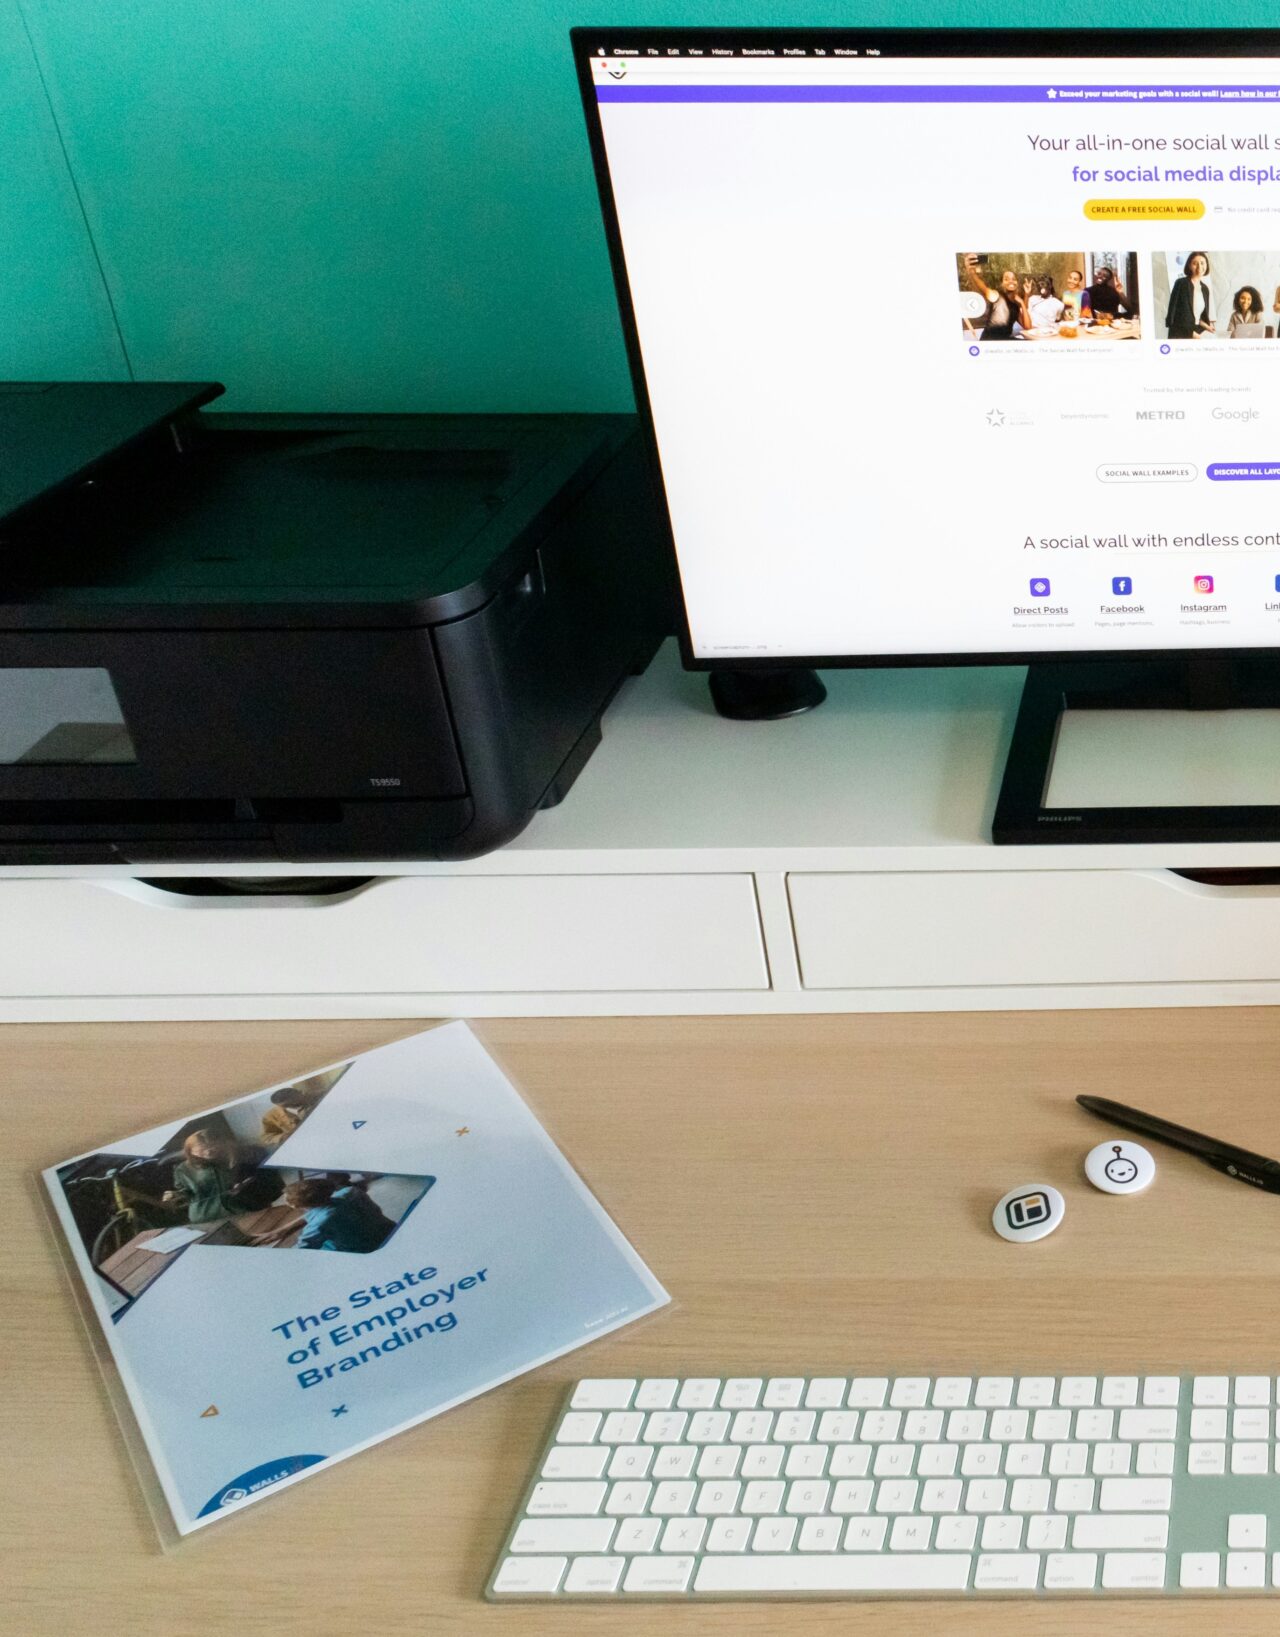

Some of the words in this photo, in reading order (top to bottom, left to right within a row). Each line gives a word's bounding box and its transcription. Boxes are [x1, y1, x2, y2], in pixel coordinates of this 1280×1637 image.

[712, 48, 733, 56] History
[866, 48, 880, 56] Help
[1102, 90, 1137, 98] marketing
[1139, 90, 1156, 98] goals
[1028, 134, 1070, 150] Your
[1075, 134, 1167, 150] all-in-one
[1173, 134, 1227, 150] social
[1231, 134, 1269, 150] wall
[1072, 166, 1098, 182] for
[1104, 166, 1159, 182] social
[1165, 166, 1224, 181] media
[1136, 410, 1185, 421] METRO
[1211, 407, 1260, 423] Google
[1023, 536, 1035, 549] A
[1040, 534, 1089, 549] social
[1094, 534, 1128, 549] wall
[1132, 533, 1168, 548] with
[1172, 533, 1239, 547] endless
[1014, 606, 1041, 614] Direct
[1043, 606, 1068, 614] Posts
[1100, 604, 1145, 613] Facebook
[1180, 603, 1227, 613] Instagram
[272, 1306, 341, 1340] The
[348, 1266, 437, 1308] State
[287, 1337, 321, 1364] of
[329, 1268, 488, 1346] Employer
[297, 1312, 458, 1389] Branding
